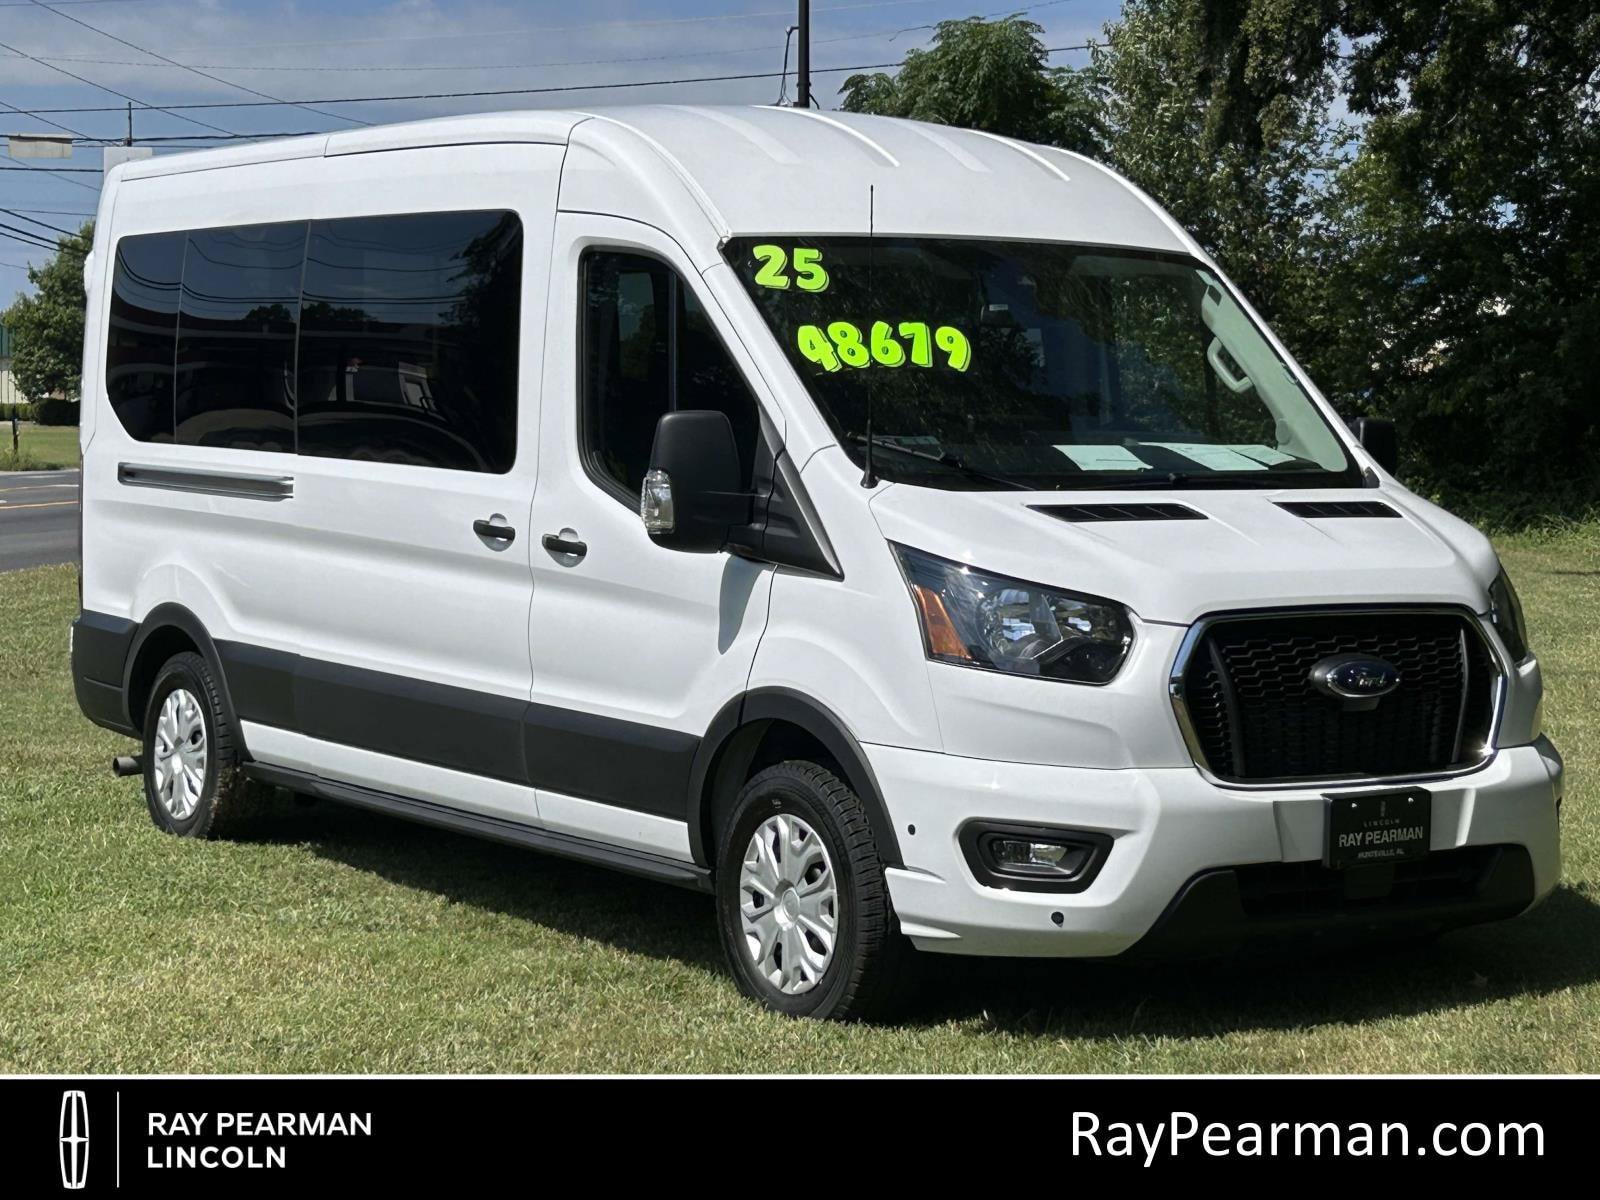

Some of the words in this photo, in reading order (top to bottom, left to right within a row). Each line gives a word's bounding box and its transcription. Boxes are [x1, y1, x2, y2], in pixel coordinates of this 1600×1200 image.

[753, 244, 829, 293] 25
[797, 320, 972, 373] 48679
[1339, 832, 1362, 847] RAY
[1366, 827, 1423, 844] PEARMAN
